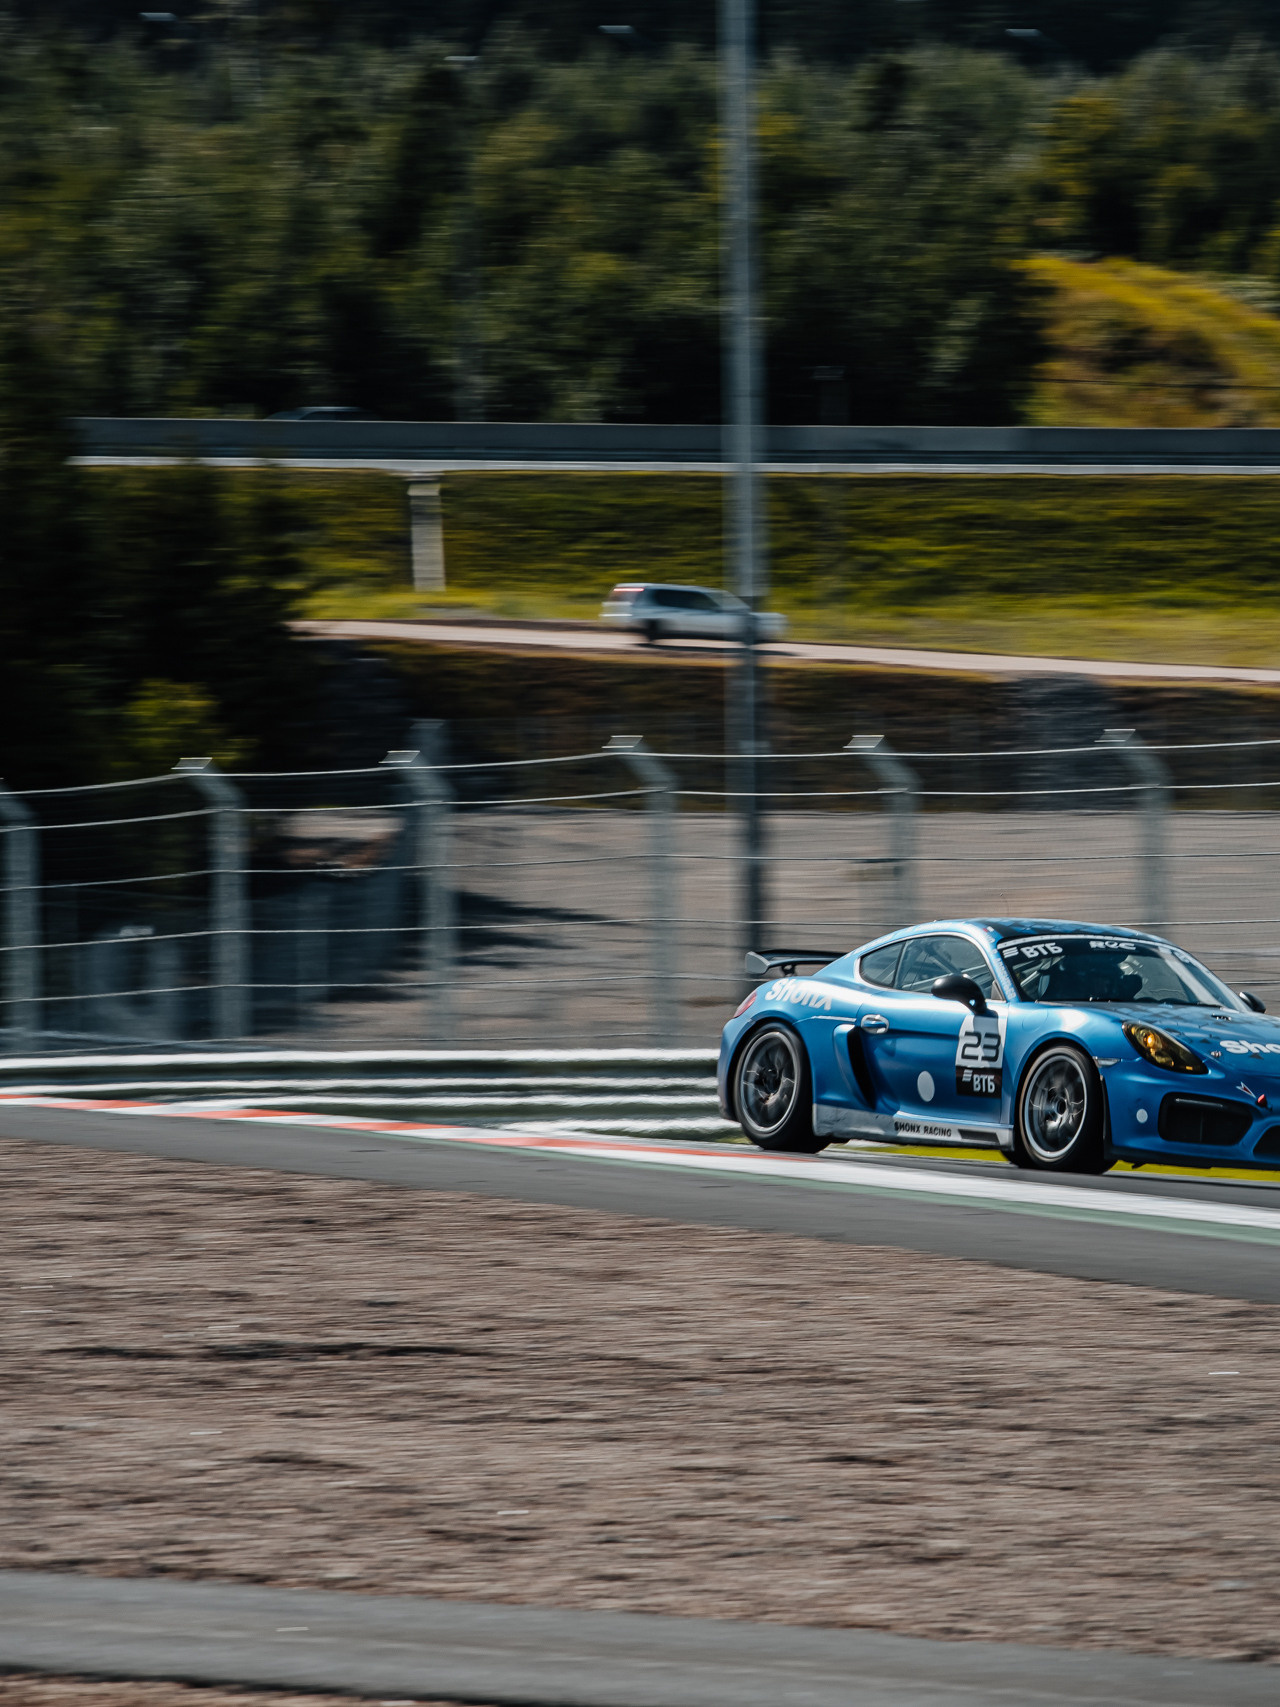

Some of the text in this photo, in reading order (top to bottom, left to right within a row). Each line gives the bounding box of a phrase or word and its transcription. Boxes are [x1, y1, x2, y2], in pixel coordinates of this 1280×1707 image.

[1020, 942, 1063, 958] ВТБ
[961, 1030, 1001, 1063] 23
[972, 1074, 996, 1094] ВТБ
[894, 1121, 952, 1137] SHONX RACING
